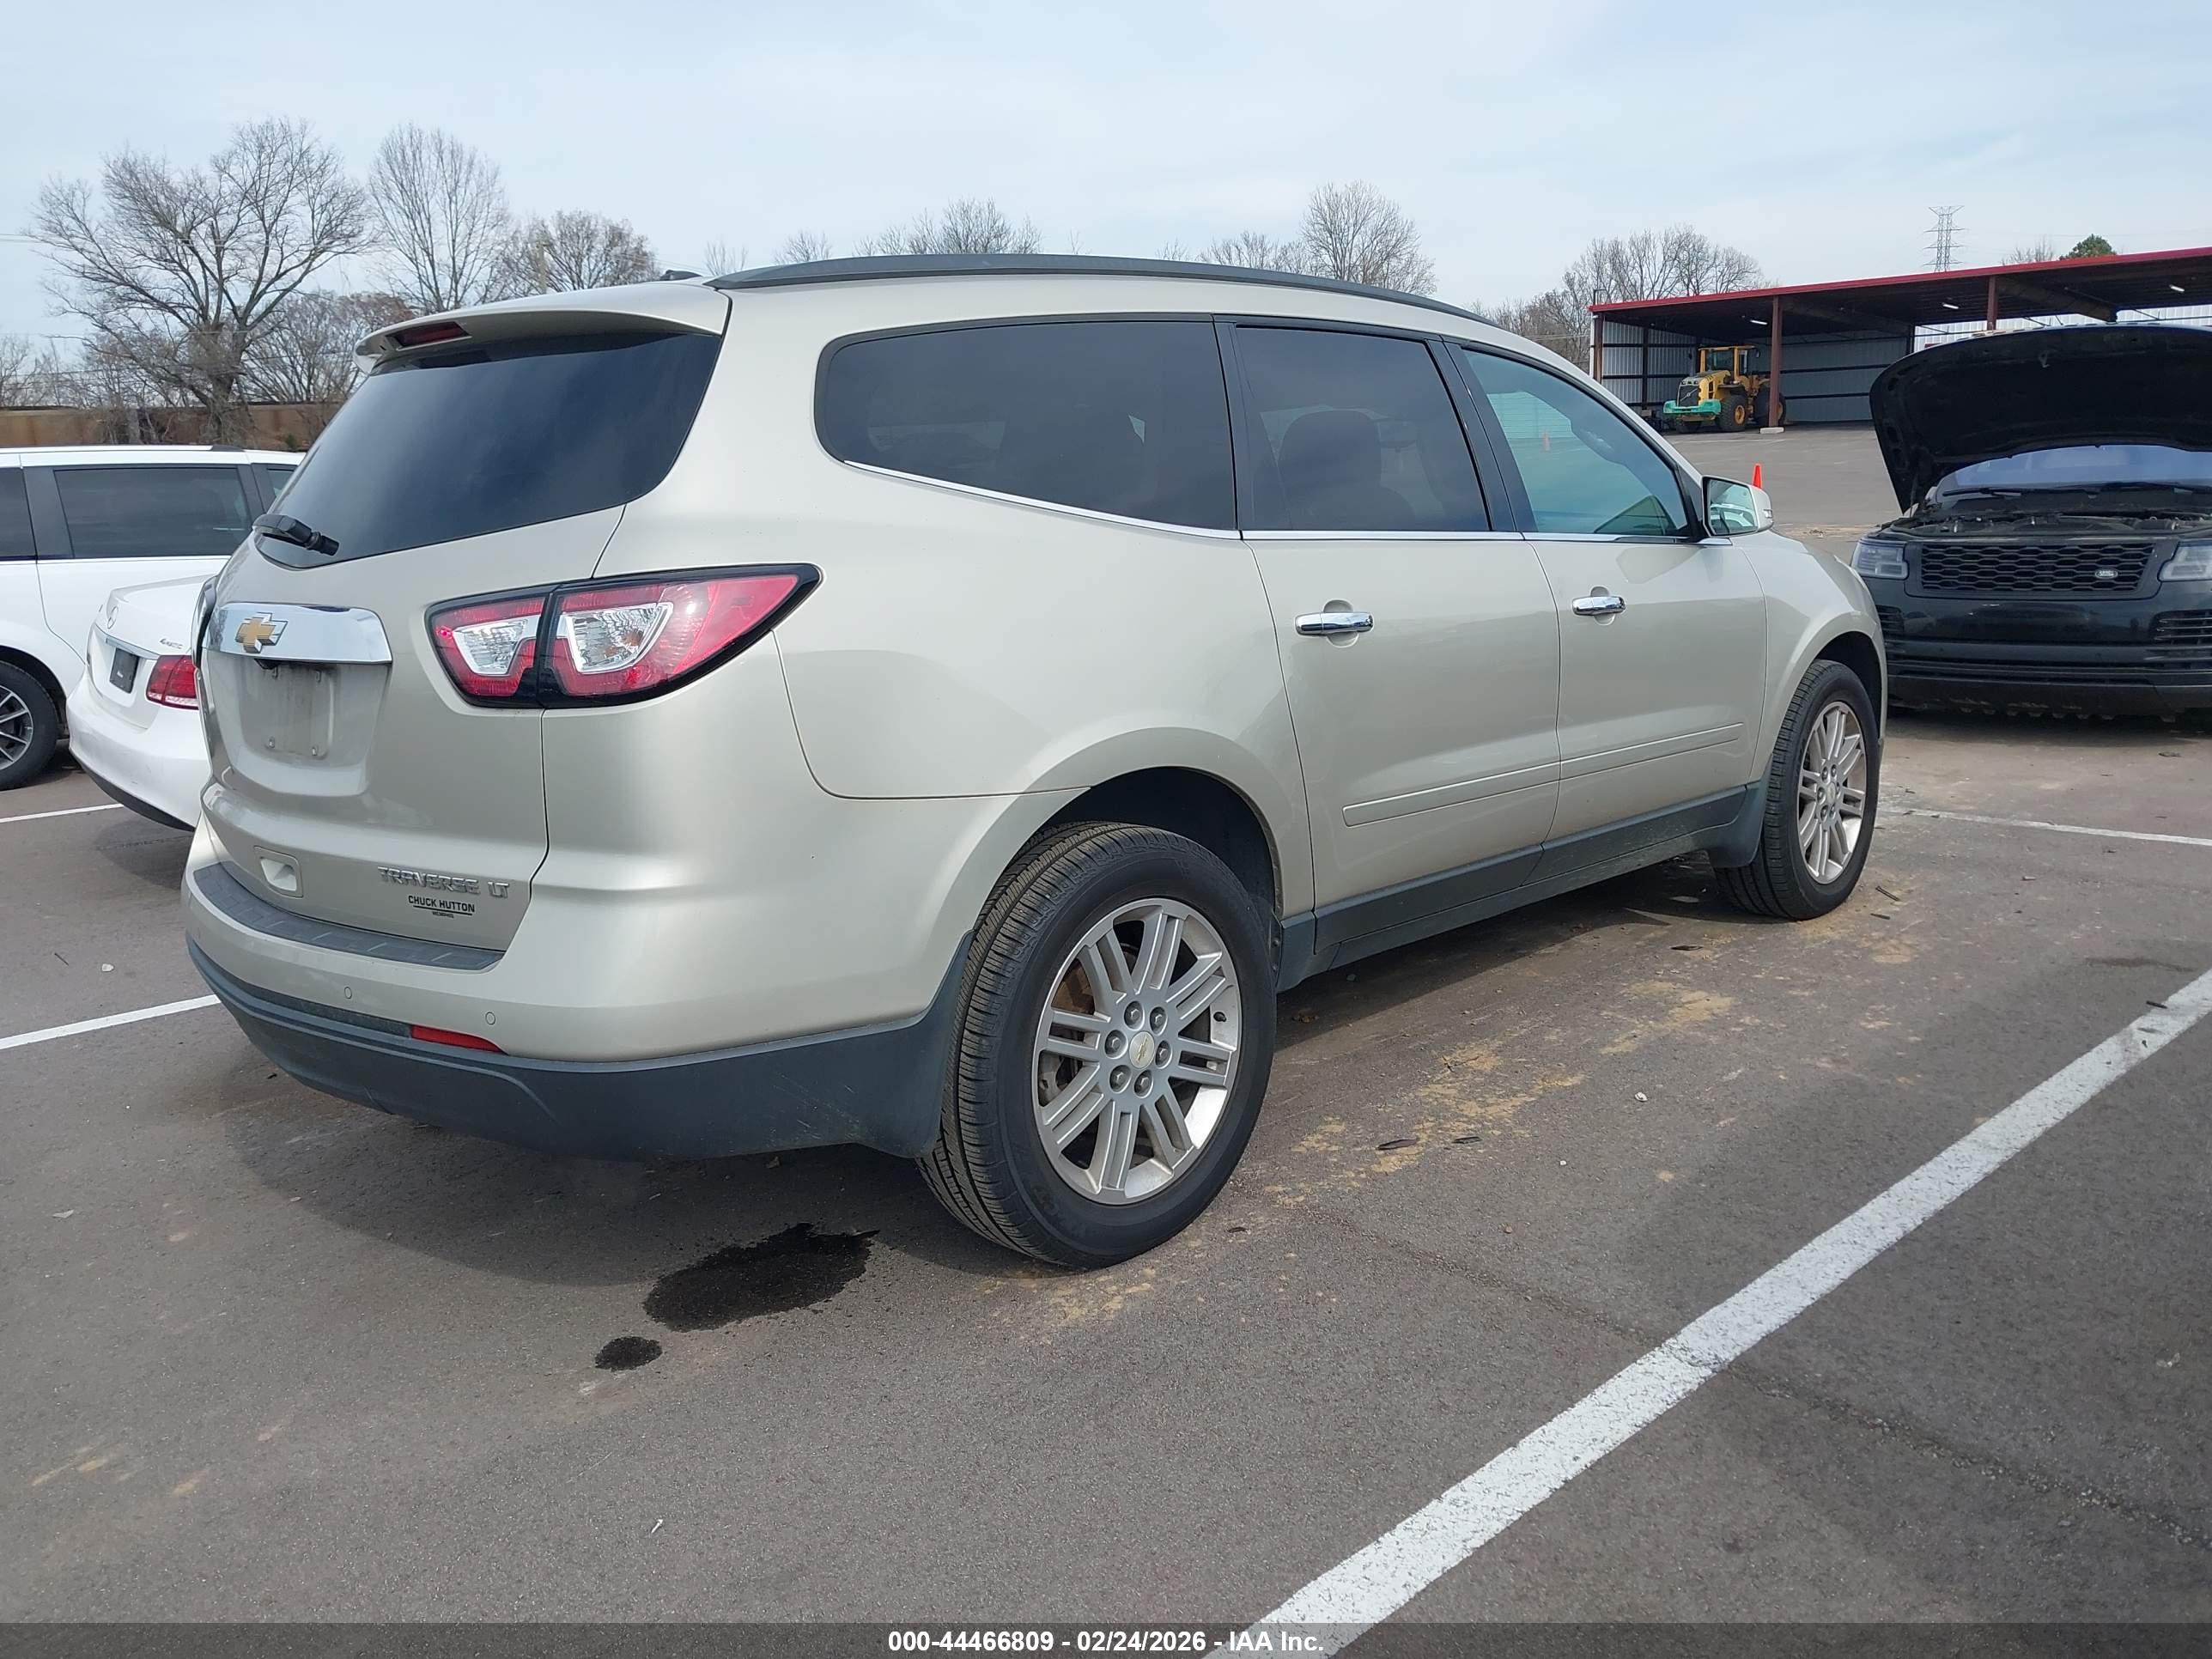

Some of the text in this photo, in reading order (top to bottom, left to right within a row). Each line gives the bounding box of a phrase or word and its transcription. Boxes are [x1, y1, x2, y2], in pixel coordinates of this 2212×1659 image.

[378, 866, 510, 899] TRAVERSE LT
[408, 895, 475, 913] CHUCK HUTTON
